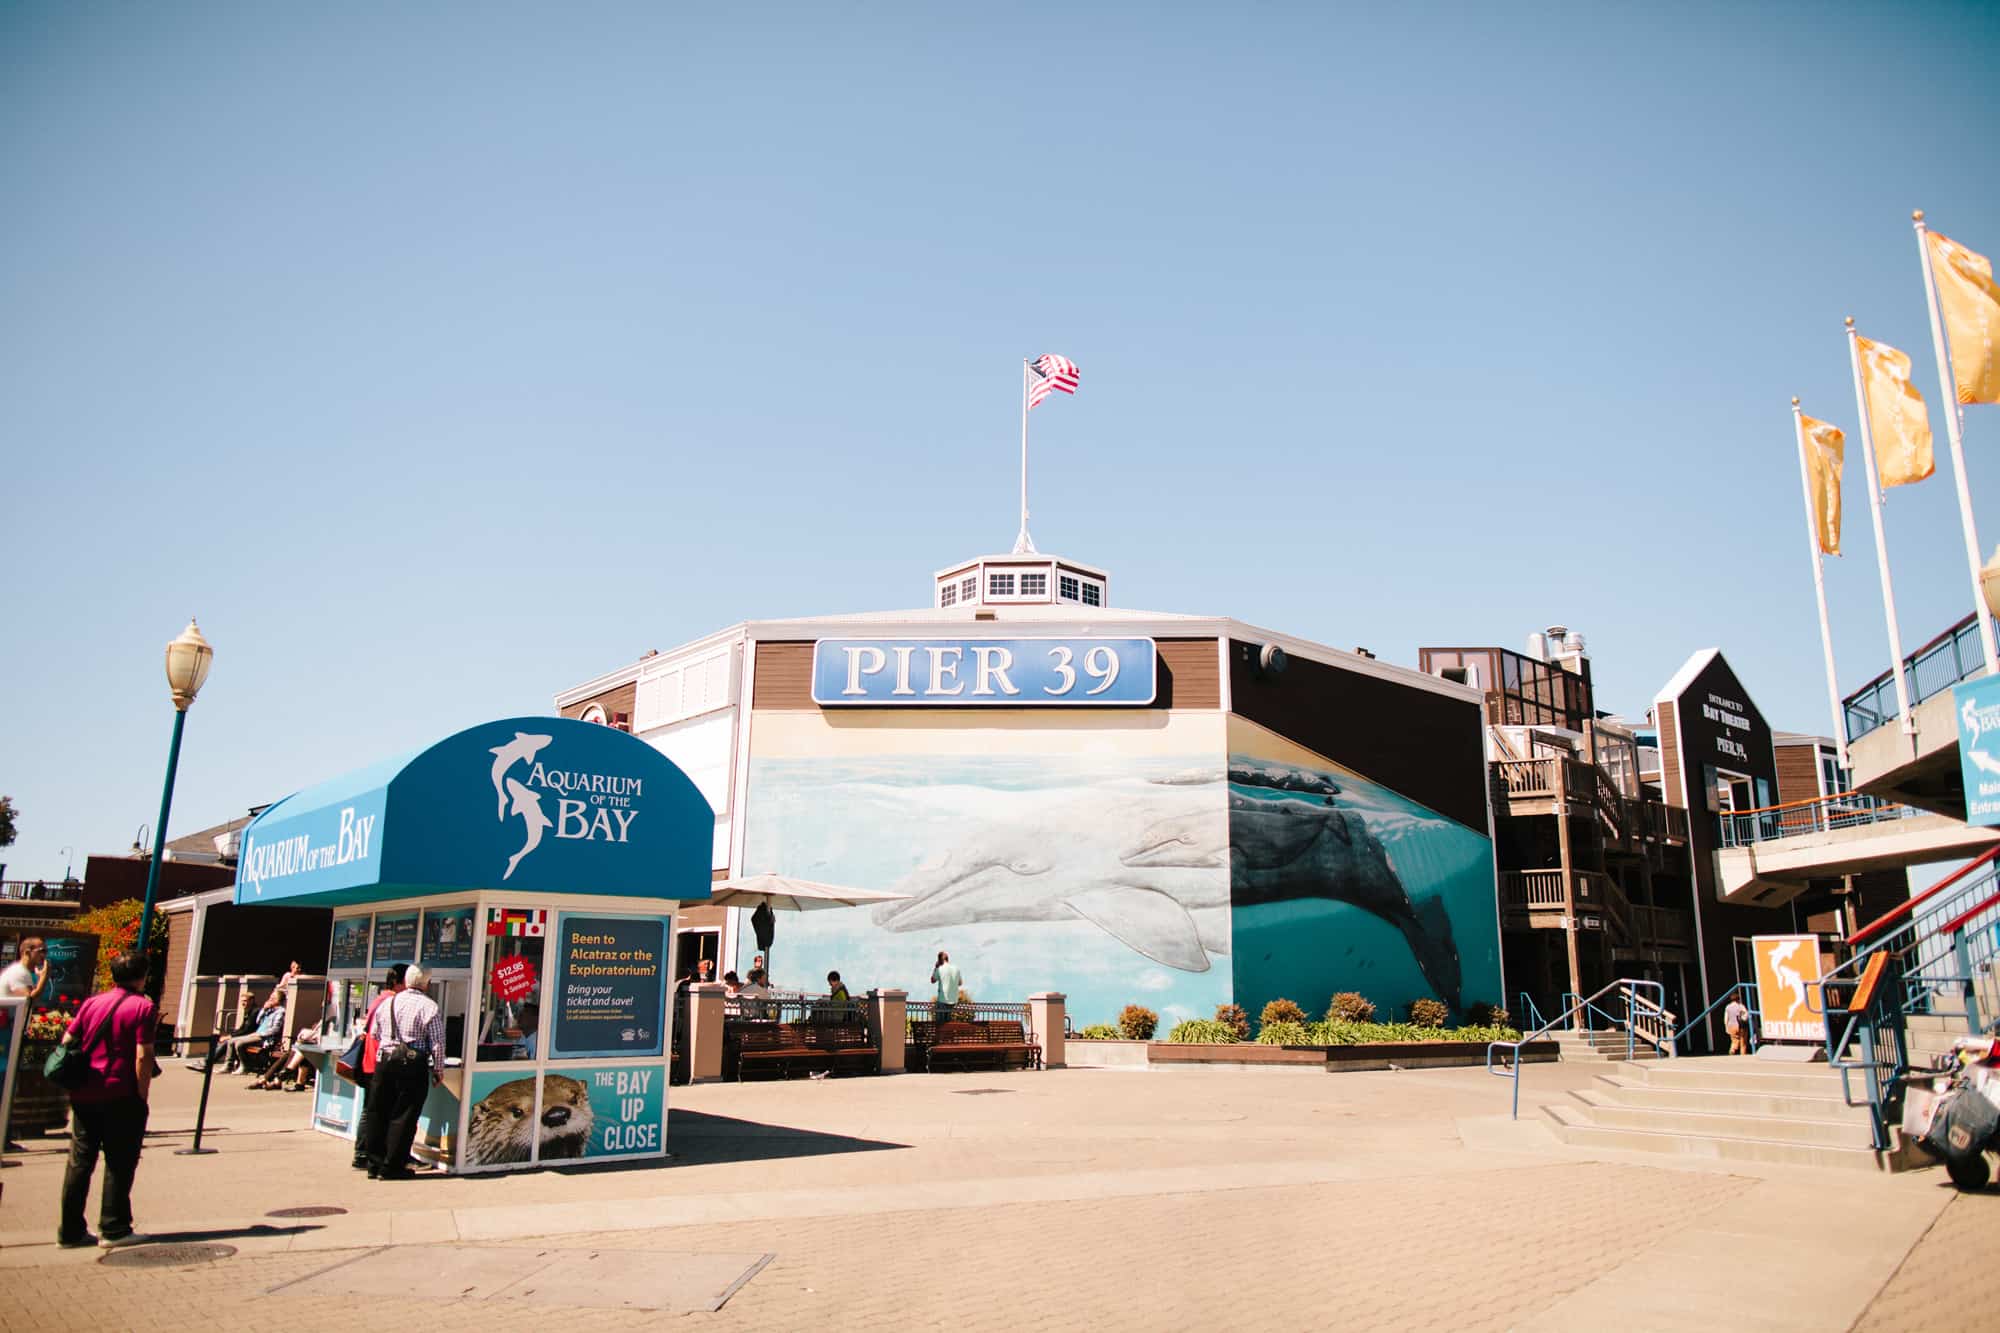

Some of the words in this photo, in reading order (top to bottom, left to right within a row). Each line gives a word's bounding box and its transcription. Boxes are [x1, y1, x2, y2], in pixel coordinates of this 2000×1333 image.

[841, 646, 1021, 696] PIER
[1043, 645, 1121, 696] 39
[1703, 703, 1720, 721] BAY
[1716, 736, 1736, 756] PIER
[526, 762, 642, 797] AQUARIUM
[590, 794, 606, 806] OF
[609, 796, 631, 808] THE
[554, 798, 639, 842] BAY
[241, 834, 310, 896] AQUARIUM
[307, 848, 320, 872] OF
[320, 843, 337, 869] THE
[336, 806, 376, 865] BAY
[571, 932, 601, 945] Been
[603, 933, 616, 945] to
[570, 948, 618, 961] Alcatraz
[619, 951, 632, 961] or
[634, 949, 653, 961] the
[497, 960, 525, 979] $12.95
[569, 963, 657, 978] Exploratorium?
[567, 984, 591, 996] Bring
[591, 986, 613, 997] your
[566, 995, 591, 1006] ticket
[592, 996, 611, 1006] and
[611, 996, 634, 1006] save!
[594, 1071, 615, 1087] THE
[616, 1069, 653, 1096] BAY
[621, 1097, 645, 1122] UP
[603, 1123, 658, 1151] CLOSE
